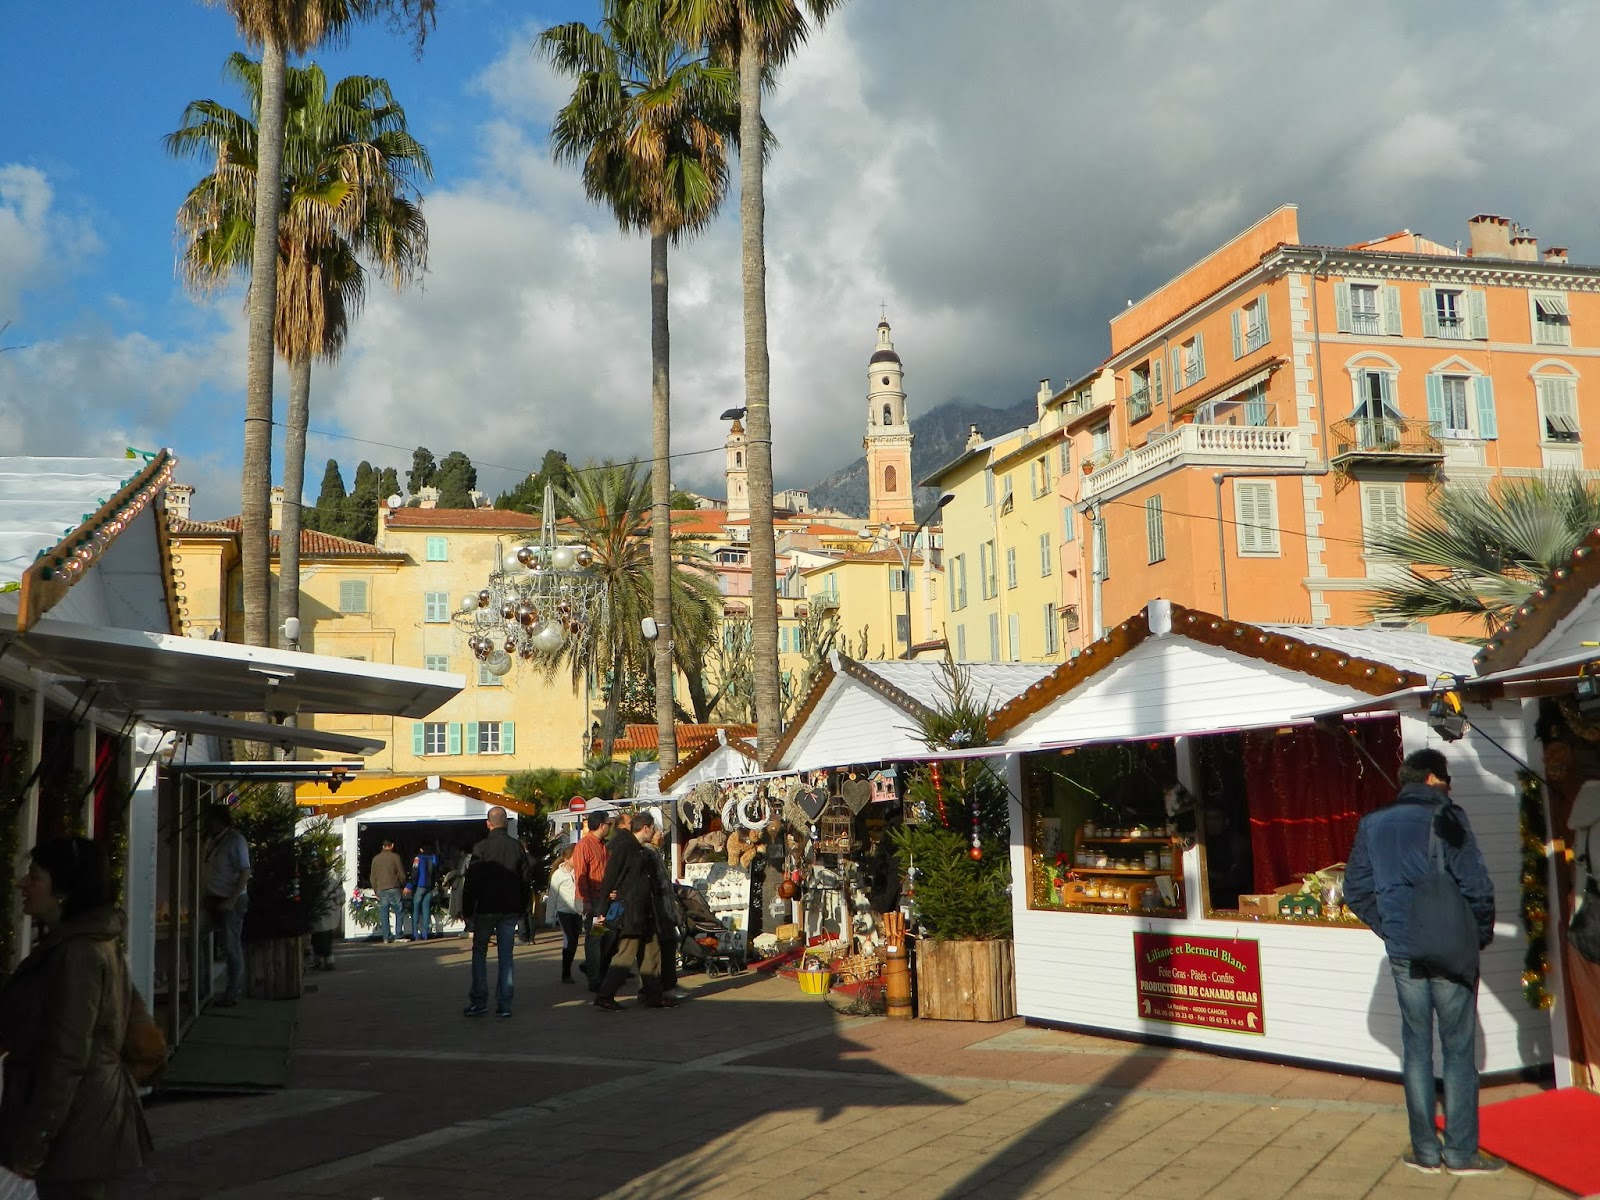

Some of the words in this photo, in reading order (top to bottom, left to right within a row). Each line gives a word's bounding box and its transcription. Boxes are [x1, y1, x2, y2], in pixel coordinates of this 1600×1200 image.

[1146, 946, 1173, 963] Liliane
[1175, 945, 1183, 954] et
[1184, 943, 1219, 958] Bernard
[1221, 949, 1247, 973] Blanc
[1158, 966, 1171, 977] Foie
[1172, 967, 1186, 979] Gras
[1211, 971, 1235, 984] Confits
[1140, 980, 1188, 996] PRODUCTEURS
[1189, 986, 1199, 997] DE
[1200, 988, 1235, 1001] CANARDS
[1236, 991, 1258, 1003] GRAS
[1207, 1008, 1228, 1016] CAHORS
